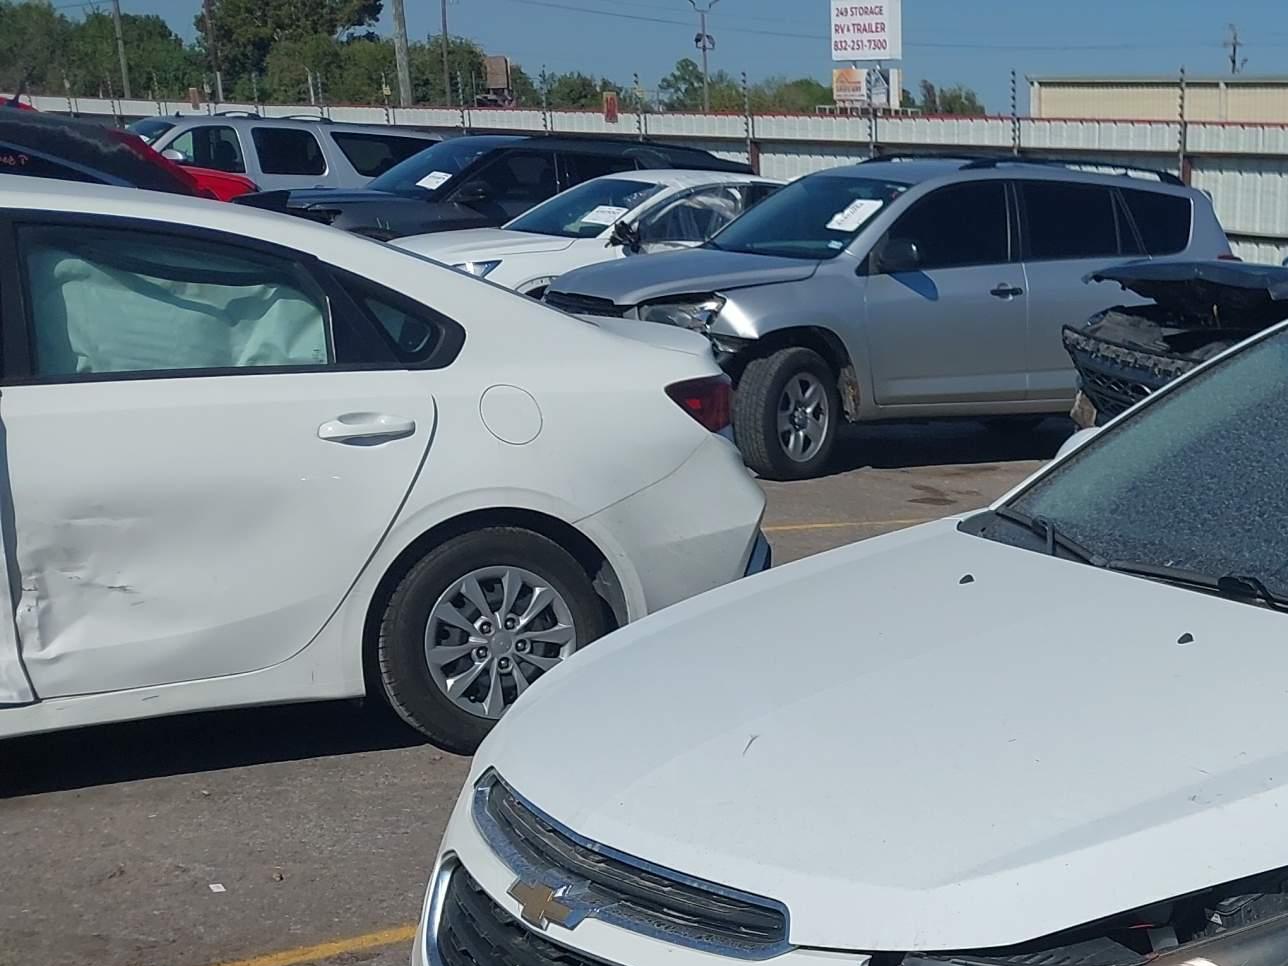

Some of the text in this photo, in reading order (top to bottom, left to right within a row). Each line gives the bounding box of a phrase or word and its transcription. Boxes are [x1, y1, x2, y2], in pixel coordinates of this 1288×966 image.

[849, 5, 884, 17] STORAGE
[834, 23, 845, 35] RV
[851, 22, 886, 34] TRAILER
[833, 39, 888, 52] 832-251-7300
